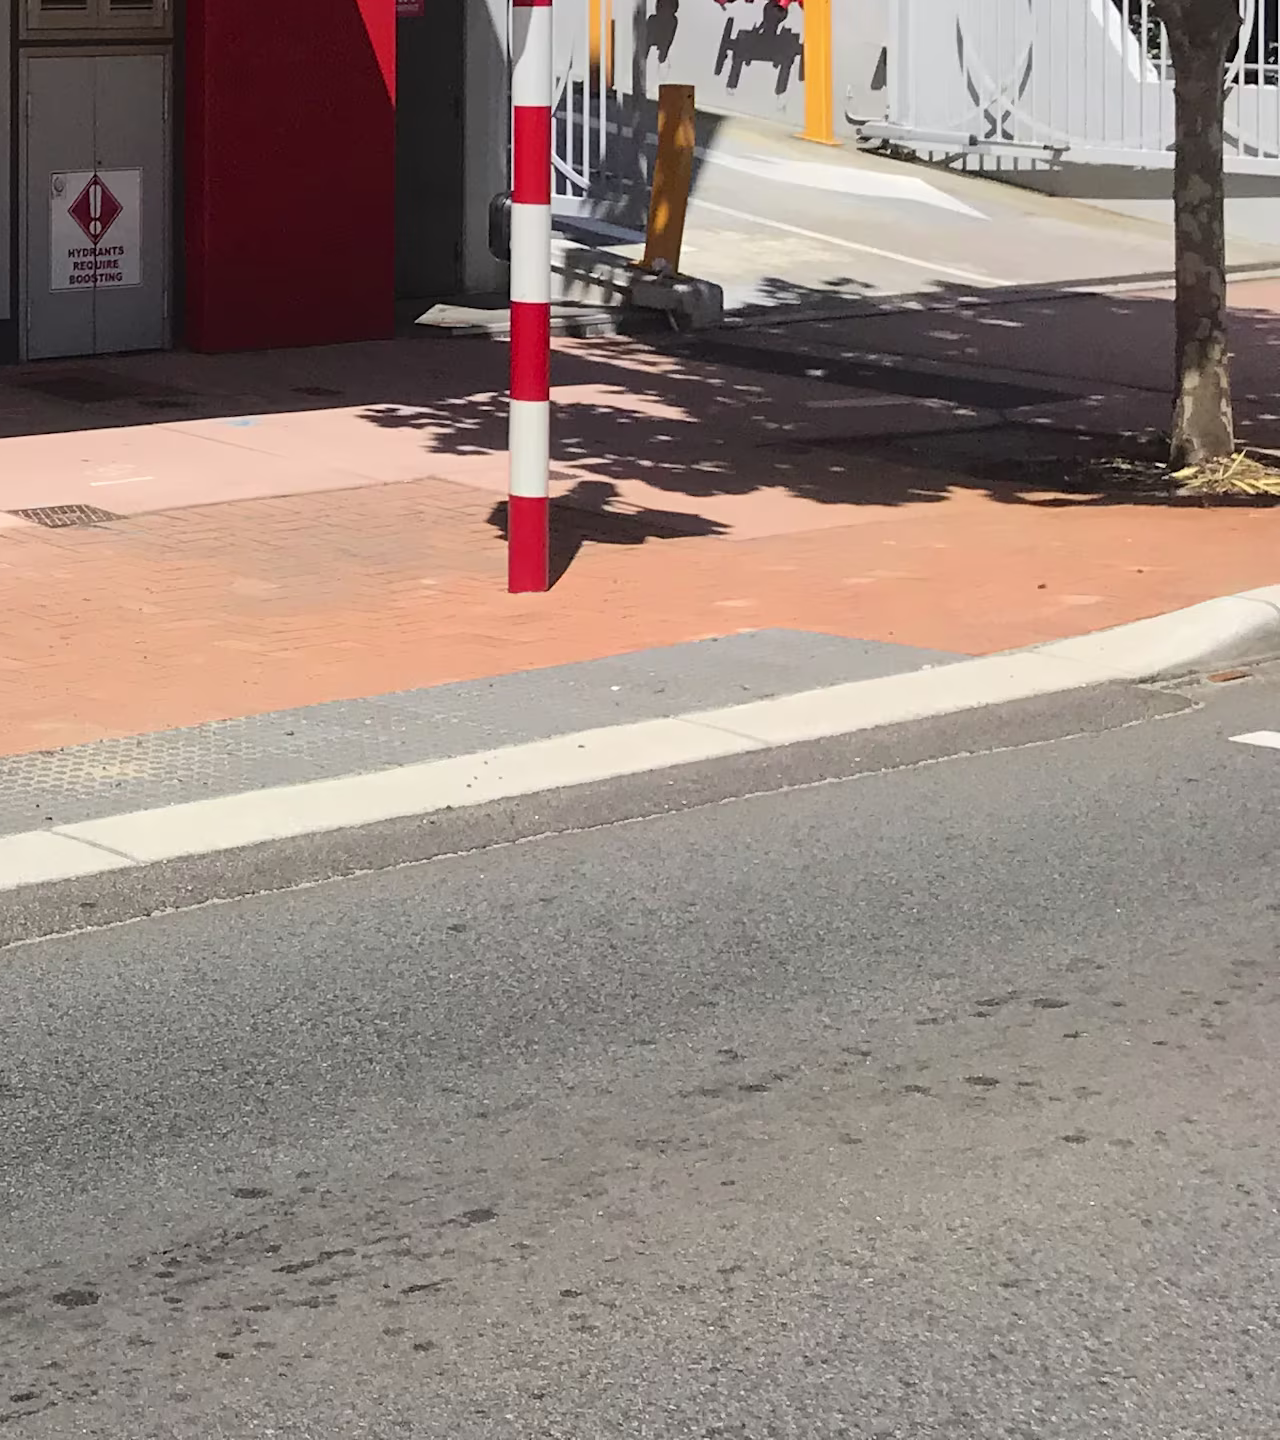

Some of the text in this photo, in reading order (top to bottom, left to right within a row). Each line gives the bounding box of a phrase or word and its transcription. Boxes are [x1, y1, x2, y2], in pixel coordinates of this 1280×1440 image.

[68, 245, 125, 258] HYDRANTS
[73, 259, 120, 271] REQUIRE
[69, 272, 123, 285] BOOSTING
